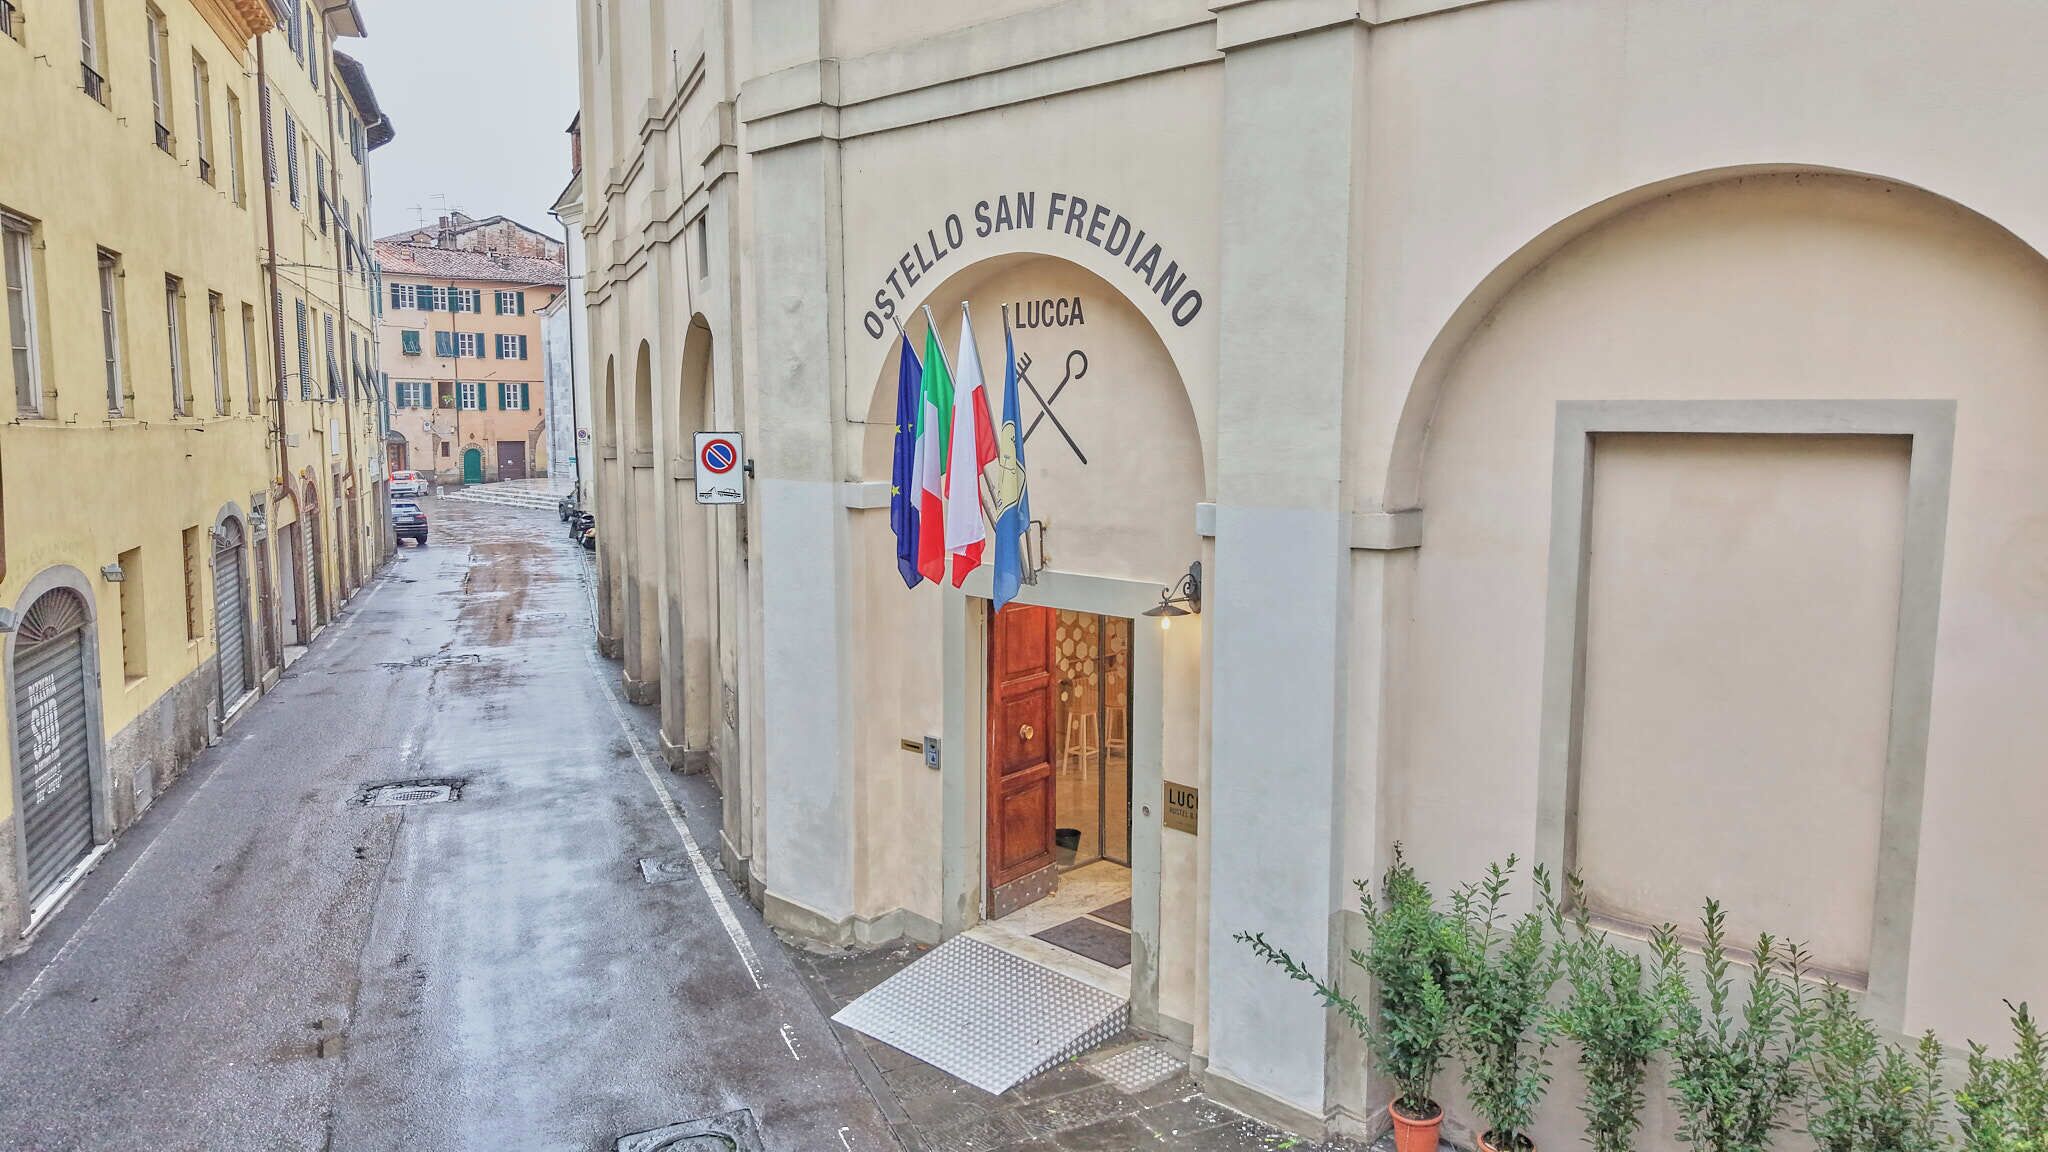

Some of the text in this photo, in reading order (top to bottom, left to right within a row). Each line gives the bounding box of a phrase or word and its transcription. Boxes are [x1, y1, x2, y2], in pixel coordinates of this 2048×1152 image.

[864, 191, 1203, 340] OSTELLO SAN FREDIANO
[1015, 296, 1085, 329] LUCCA
